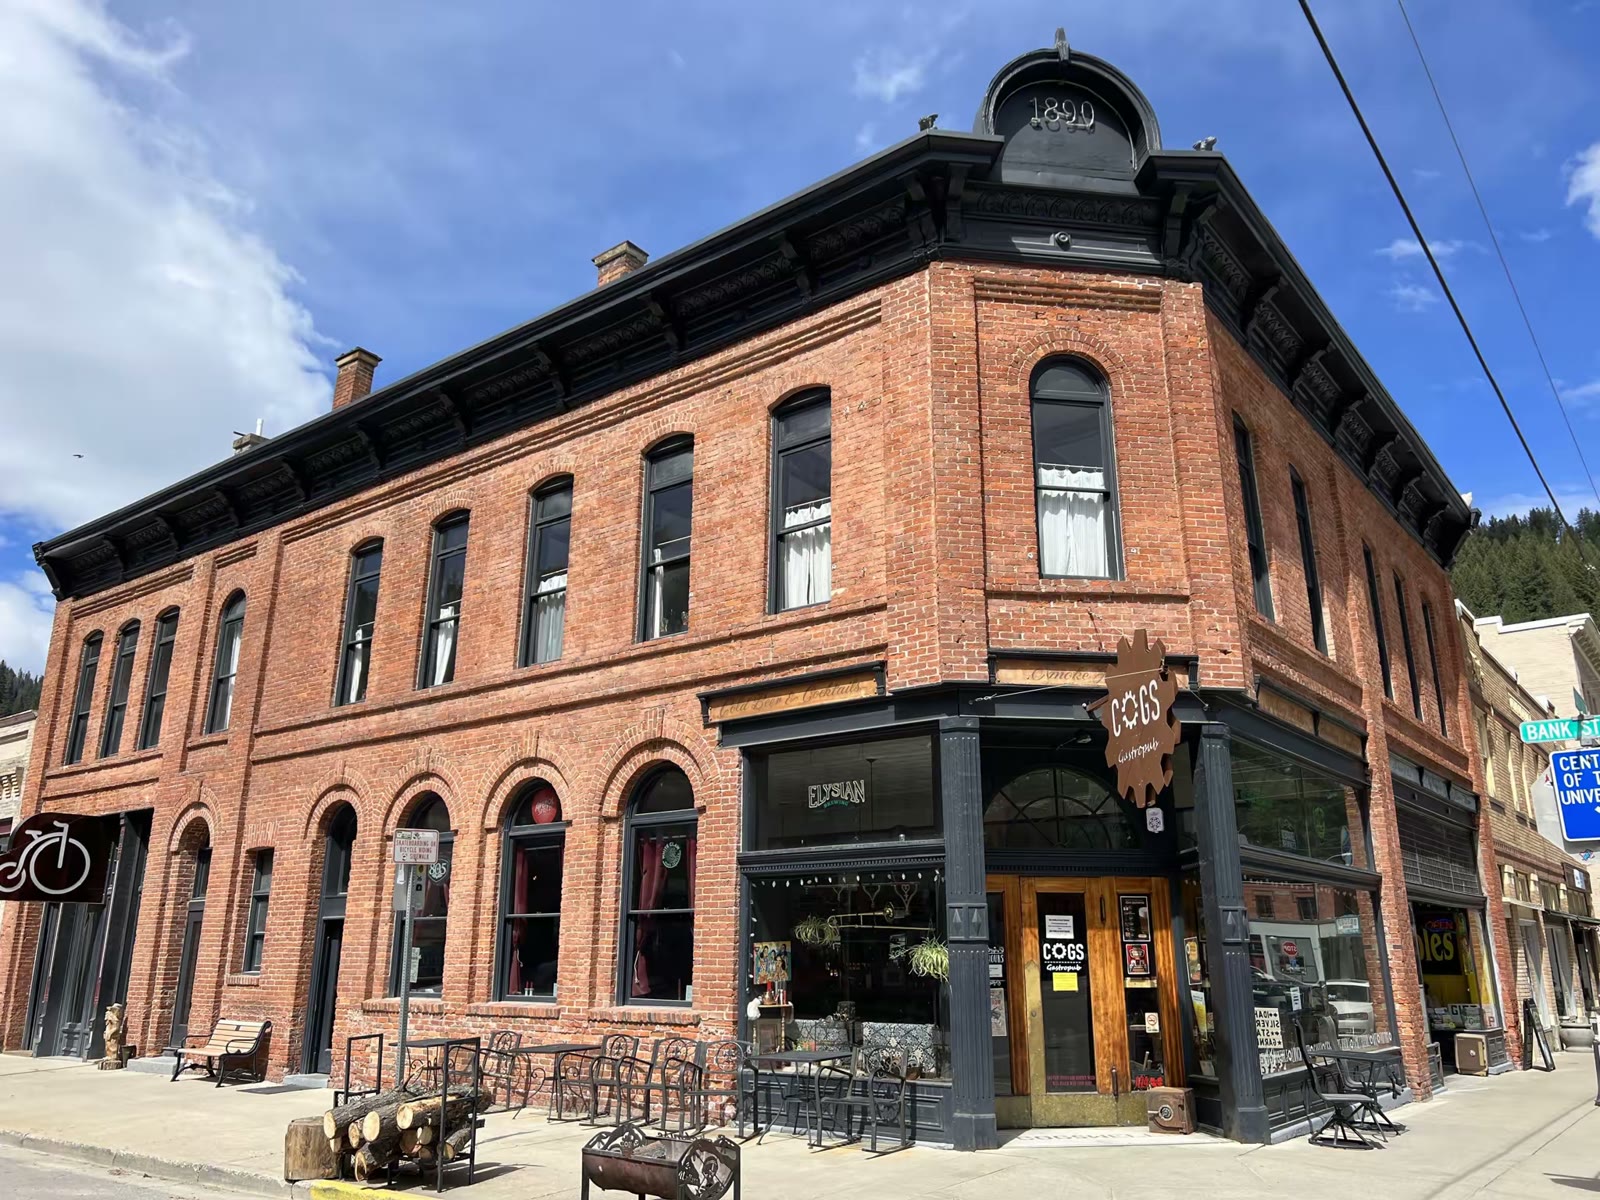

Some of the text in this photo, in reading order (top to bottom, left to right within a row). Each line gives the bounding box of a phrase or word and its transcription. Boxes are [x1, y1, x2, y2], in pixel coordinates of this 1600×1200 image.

[1029, 97, 1095, 127] 1890
[803, 681, 861, 703] Cocktails
[1111, 679, 1160, 737] COGS
[1527, 721, 1572, 740] BANK
[1118, 737, 1159, 764] Gastropub
[1560, 754, 1599, 771] CENT
[1563, 772, 1583, 788] OF
[808, 780, 865, 808] ELYSIAN
[823, 800, 849, 808] BREWING
[429, 863, 446, 874] 805
[1043, 943, 1084, 960] COGS
[1046, 964, 1082, 972] Gastropub
